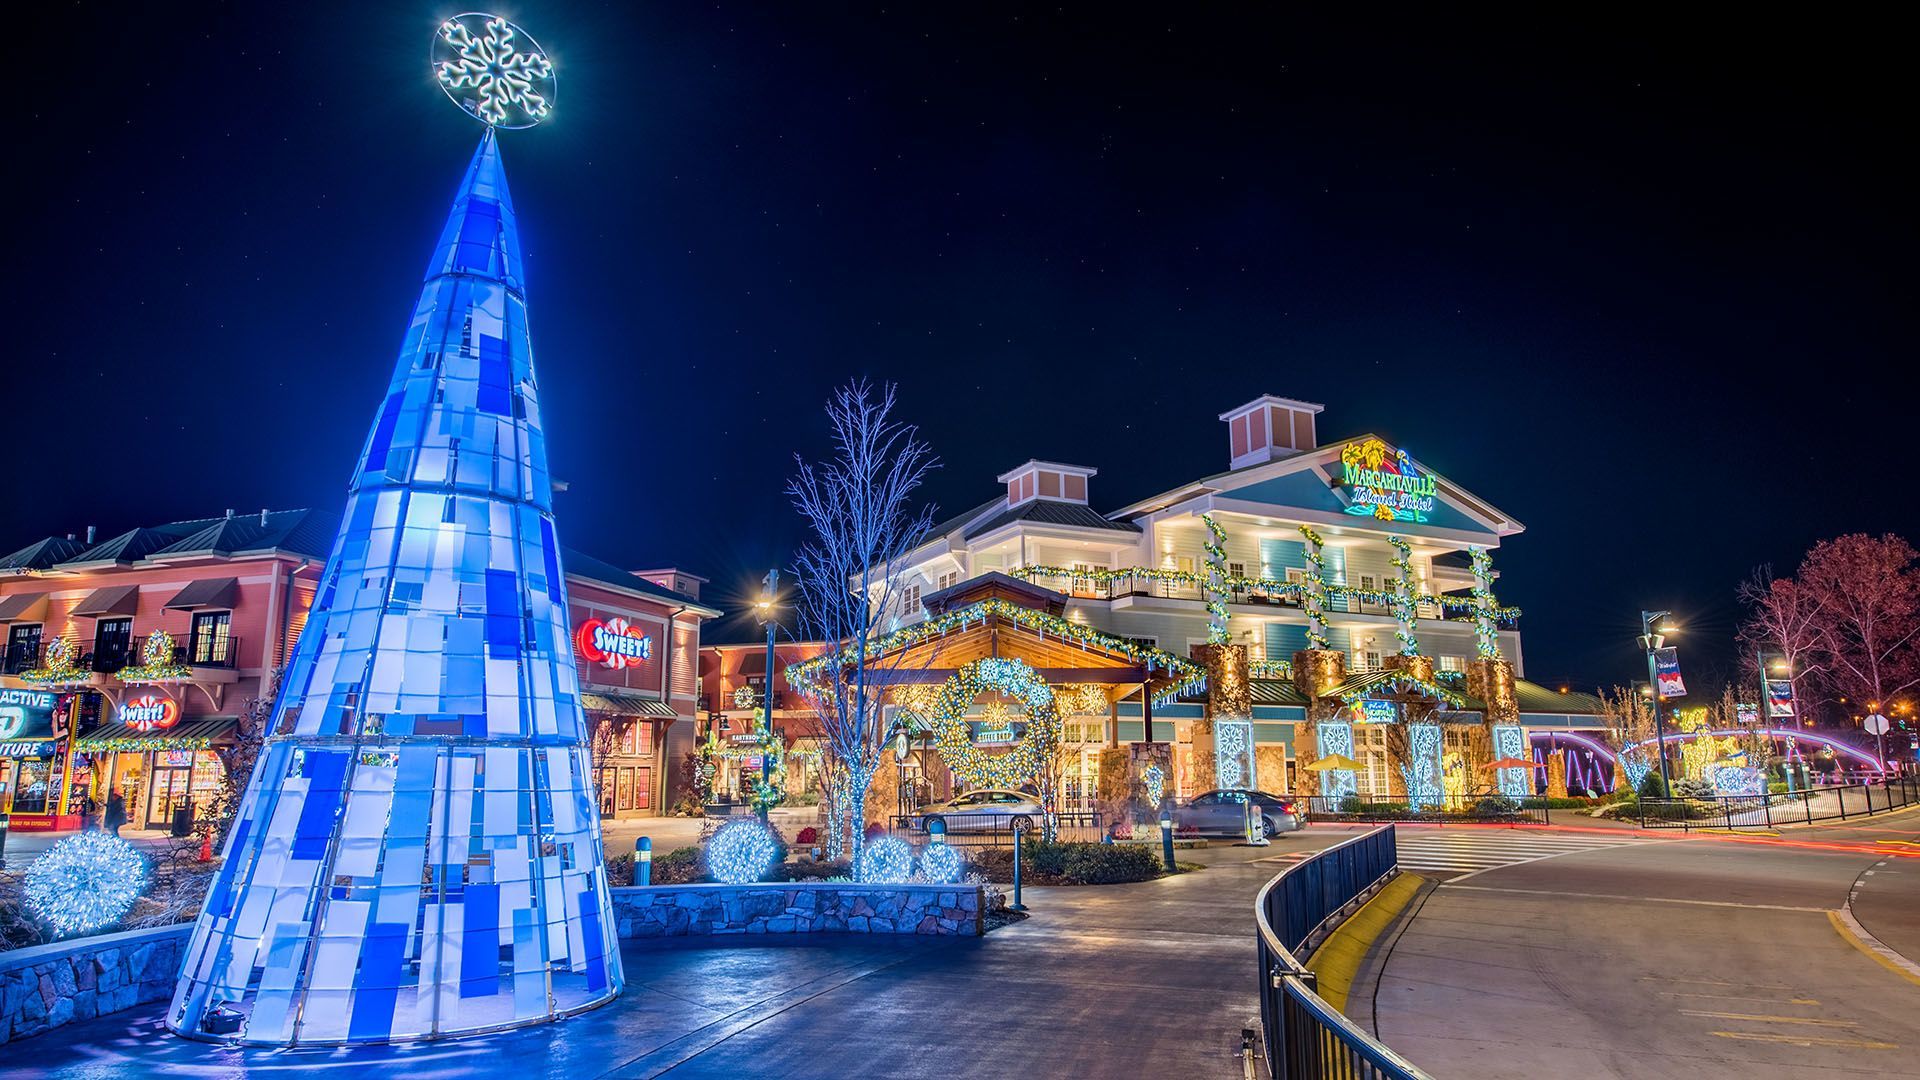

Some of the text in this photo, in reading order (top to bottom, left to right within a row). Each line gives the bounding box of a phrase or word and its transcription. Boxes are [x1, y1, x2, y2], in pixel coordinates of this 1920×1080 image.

[1343, 461, 1437, 497] MARGARITAVILLE
[1351, 486, 1433, 512] Island Hotel
[593, 625, 651, 660] SWEET!
[0, 690, 51, 708] ACTIVE
[118, 703, 165, 722] SWEET!
